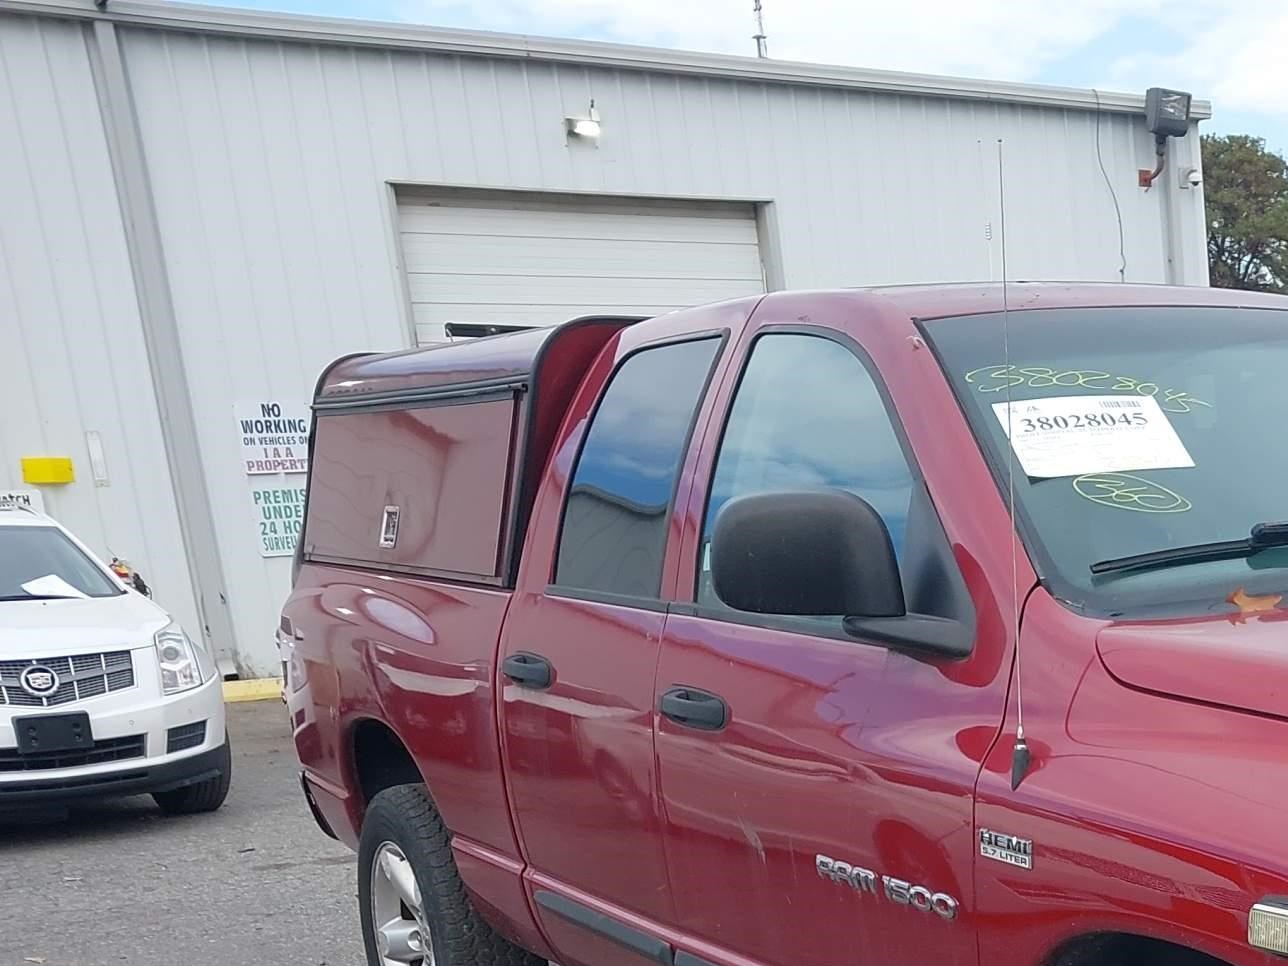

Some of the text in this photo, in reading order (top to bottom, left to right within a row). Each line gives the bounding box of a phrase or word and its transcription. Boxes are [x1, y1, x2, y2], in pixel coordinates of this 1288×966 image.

[965, 365, 1213, 413] 38028045
[260, 403, 281, 418] NO
[240, 419, 307, 434] WORKING
[1021, 412, 1149, 433] 38028045
[243, 437, 256, 446] ON
[258, 436, 297, 446] VEHICLES
[246, 458, 308, 472] PROPERT
[252, 489, 307, 505] PREMIS
[262, 504, 304, 520] UNDE
[259, 520, 302, 536] 24 HO
[979, 828, 1032, 856] HEMI
[981, 846, 1029, 866] 5.7 LITER
[815, 854, 959, 920] RAM 1500
